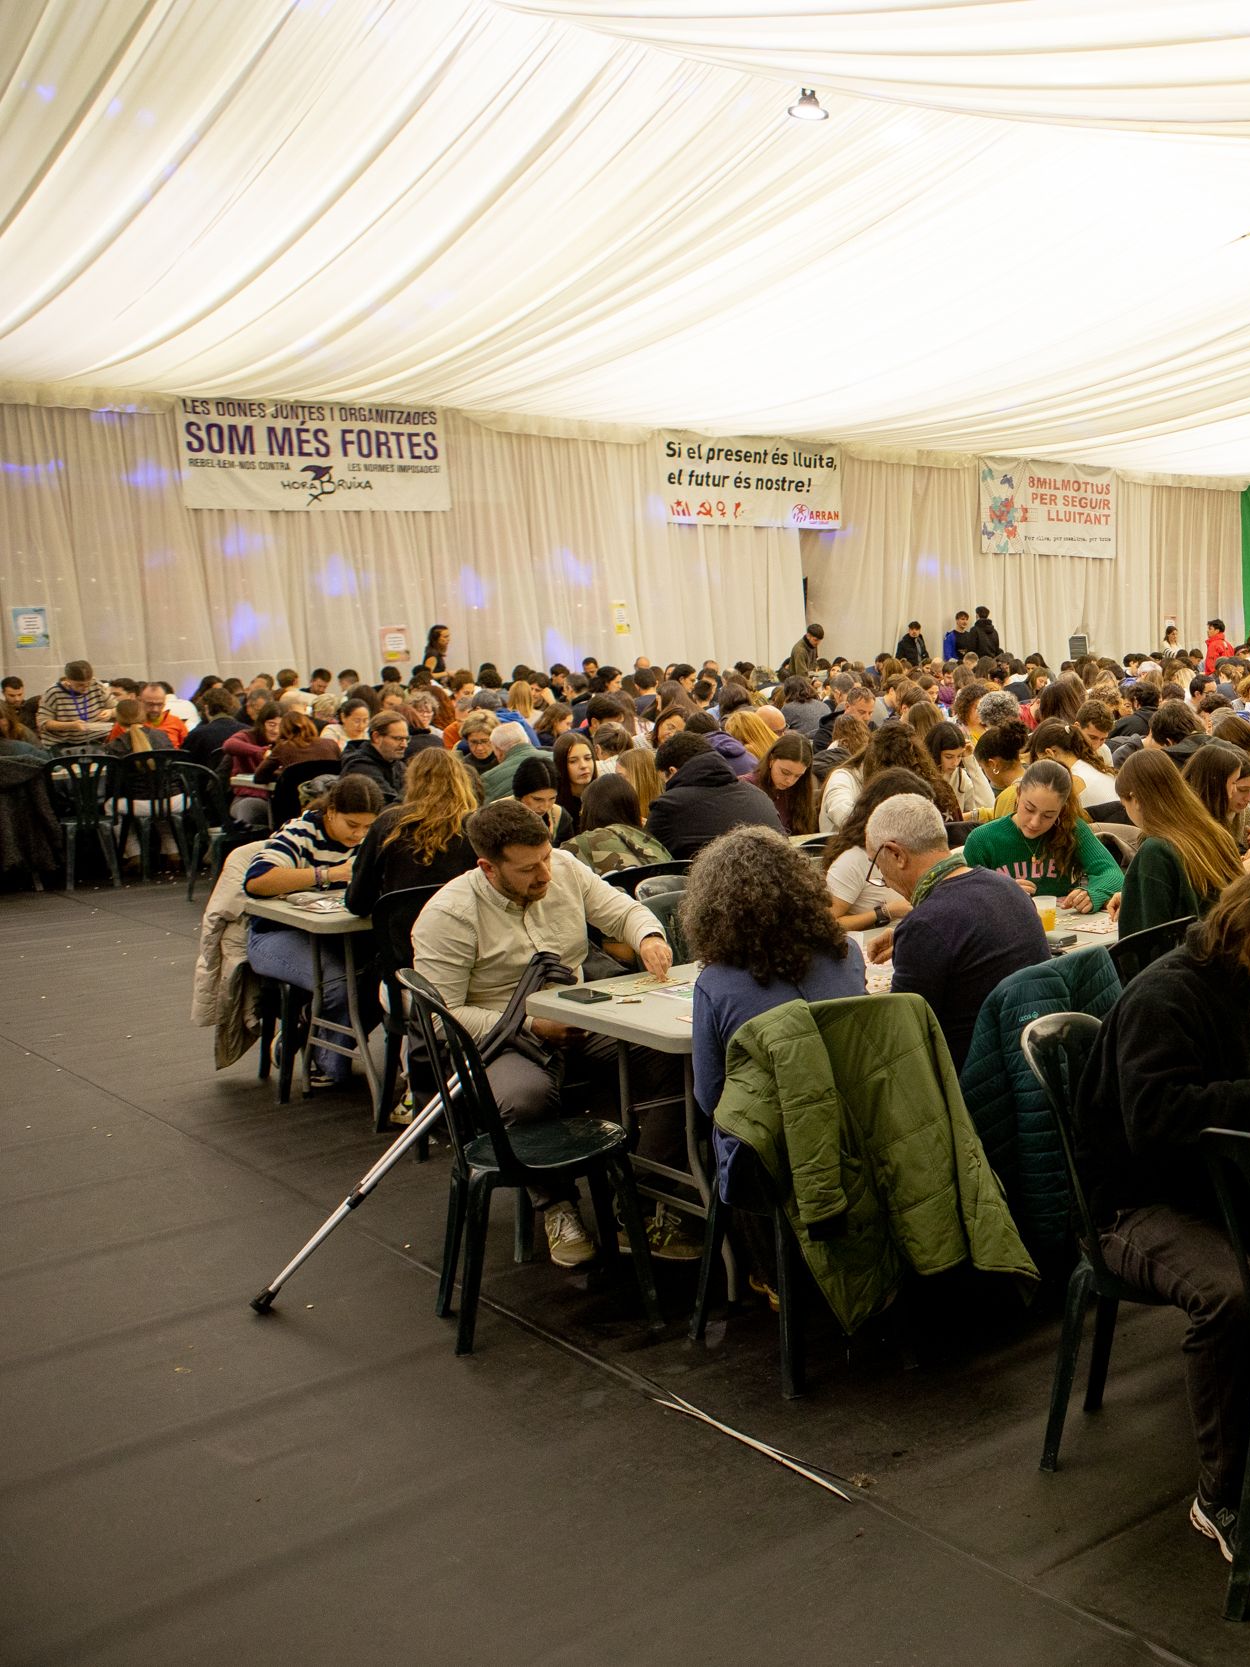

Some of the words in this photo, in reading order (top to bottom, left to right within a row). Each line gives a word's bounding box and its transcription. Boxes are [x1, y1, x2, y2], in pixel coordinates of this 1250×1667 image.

[182, 399, 211, 416] LES
[216, 401, 267, 418] DONES
[271, 403, 325, 422] JUNTES
[330, 407, 336, 422] I
[339, 407, 438, 426] ORGANITZADES
[185, 421, 256, 455] SOM
[266, 420, 331, 458] MÉS
[340, 428, 439, 460] FORTES
[258, 460, 291, 471] CONTRA
[666, 441, 682, 458] Si
[687, 444, 703, 460] el
[706, 446, 768, 465] present
[771, 447, 788, 466] és
[793, 451, 838, 472] lluita,
[347, 462, 362, 472] LES
[363, 463, 395, 473] NORMES
[667, 469, 683, 486] el
[688, 469, 730, 489] futur
[733, 471, 752, 489] és
[755, 475, 813, 493] nostre!
[1028, 476, 1111, 496] 8MILMOTIUS
[1031, 492, 1058, 506] PER
[1062, 495, 1111, 511] SEGUIR
[809, 510, 840, 521] ARRAN
[1047, 509, 1111, 526] LLUITANT
